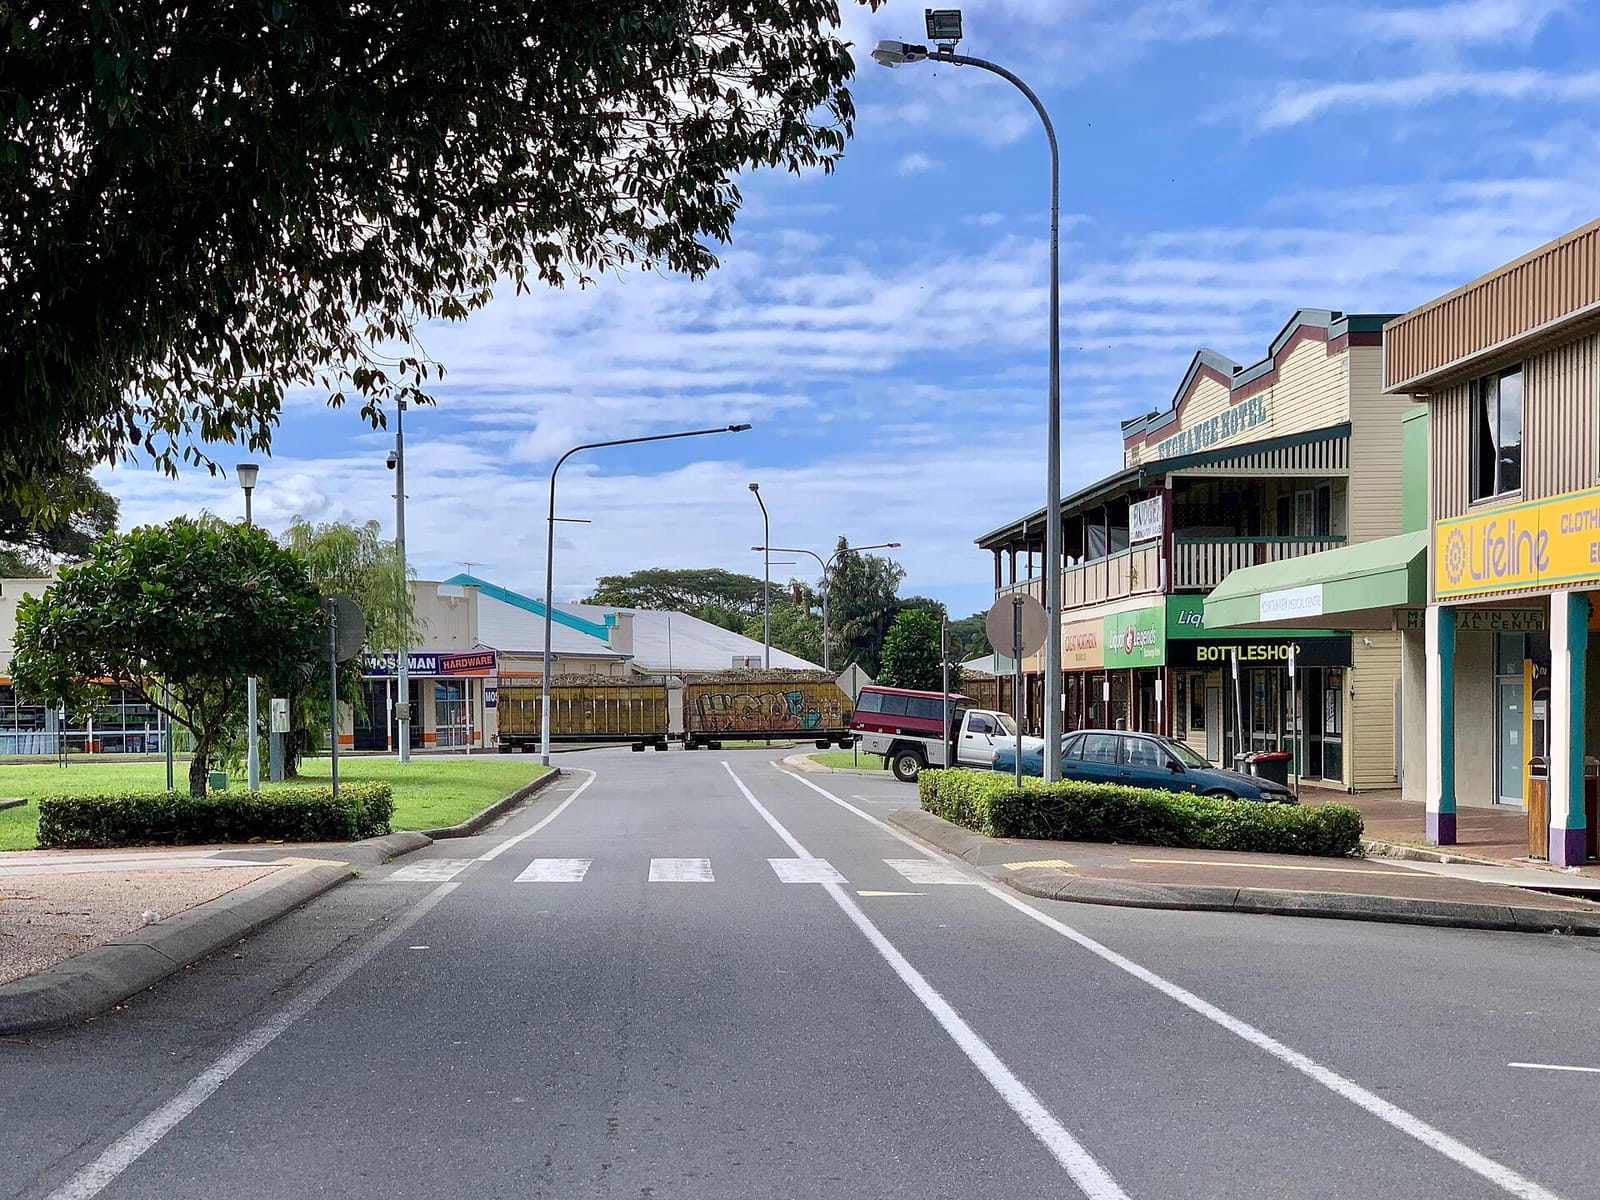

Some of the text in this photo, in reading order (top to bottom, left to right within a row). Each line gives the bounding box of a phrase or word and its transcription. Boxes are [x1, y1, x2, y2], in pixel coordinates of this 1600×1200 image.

[1157, 395, 1267, 461] EXCHANGE HOTEL
[1469, 517, 1551, 581] Lifeline
[1407, 611, 1543, 621] MTAIN VIE
[1407, 619, 1481, 629] MEAL
[364, 655, 493, 671] MOSMAN HARDWARE
